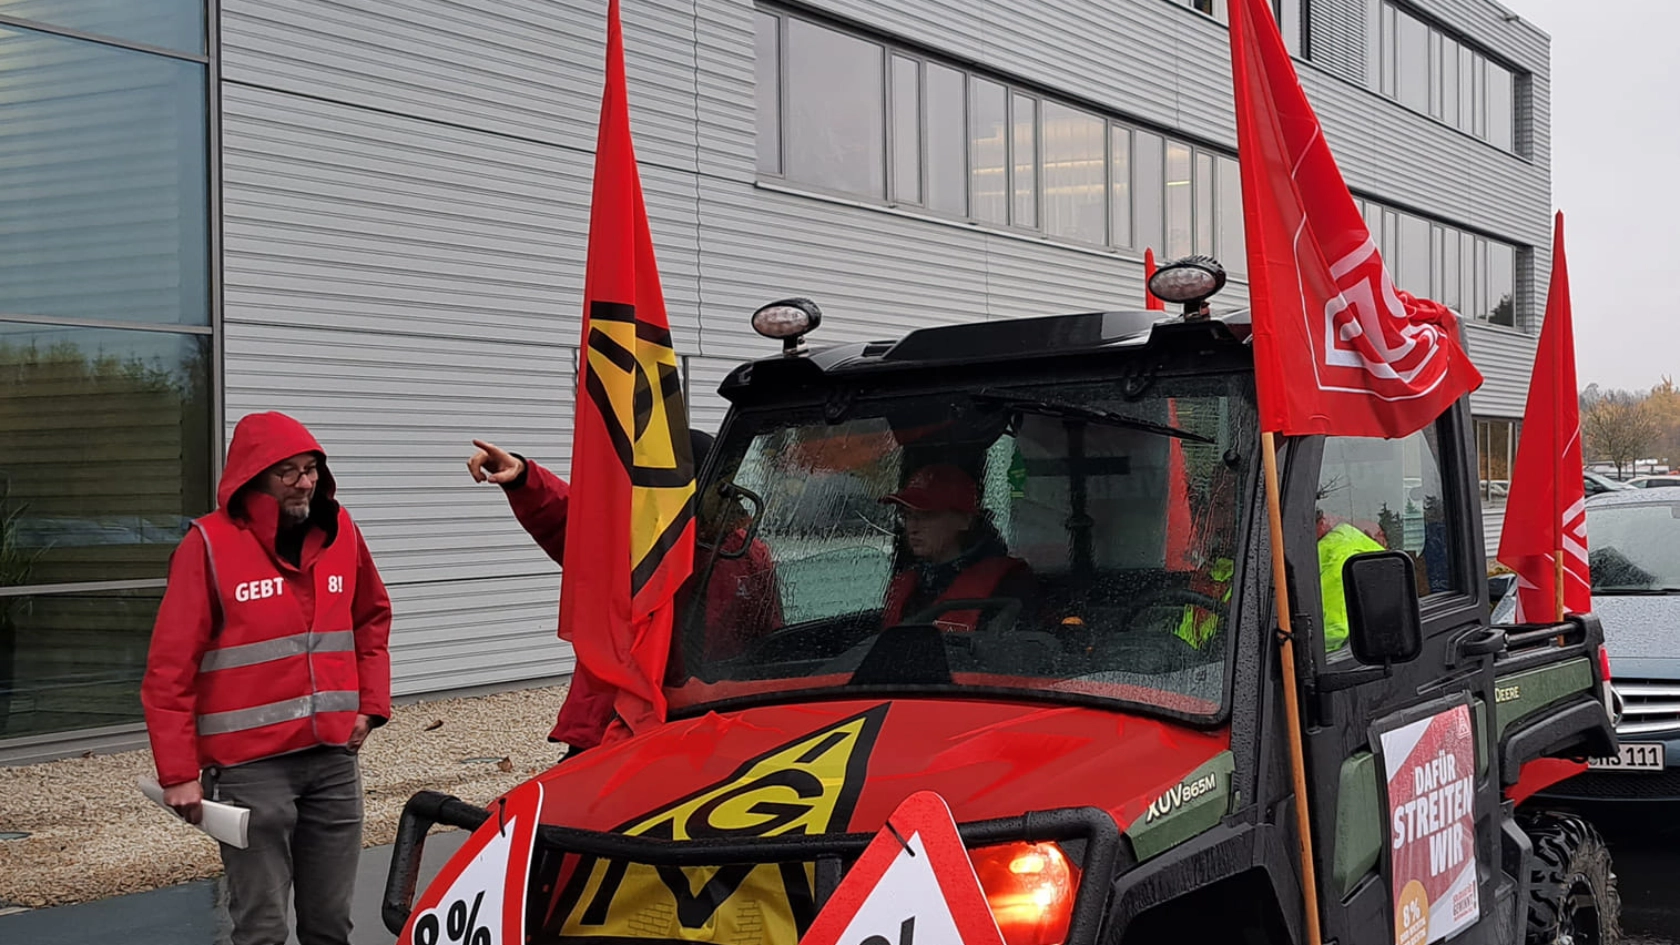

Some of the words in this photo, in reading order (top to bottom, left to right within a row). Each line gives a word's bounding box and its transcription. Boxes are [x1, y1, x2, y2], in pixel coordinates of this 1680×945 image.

[235, 577, 284, 602] GEBT
[327, 575, 343, 593] 8!
[1494, 686, 1519, 703] DEERE
[1414, 749, 1456, 796] DAFÜR
[1625, 747, 1660, 766] 111
[1393, 774, 1473, 849] STREITEN
[1429, 822, 1464, 877] WIR
[1403, 897, 1421, 929] 8%
